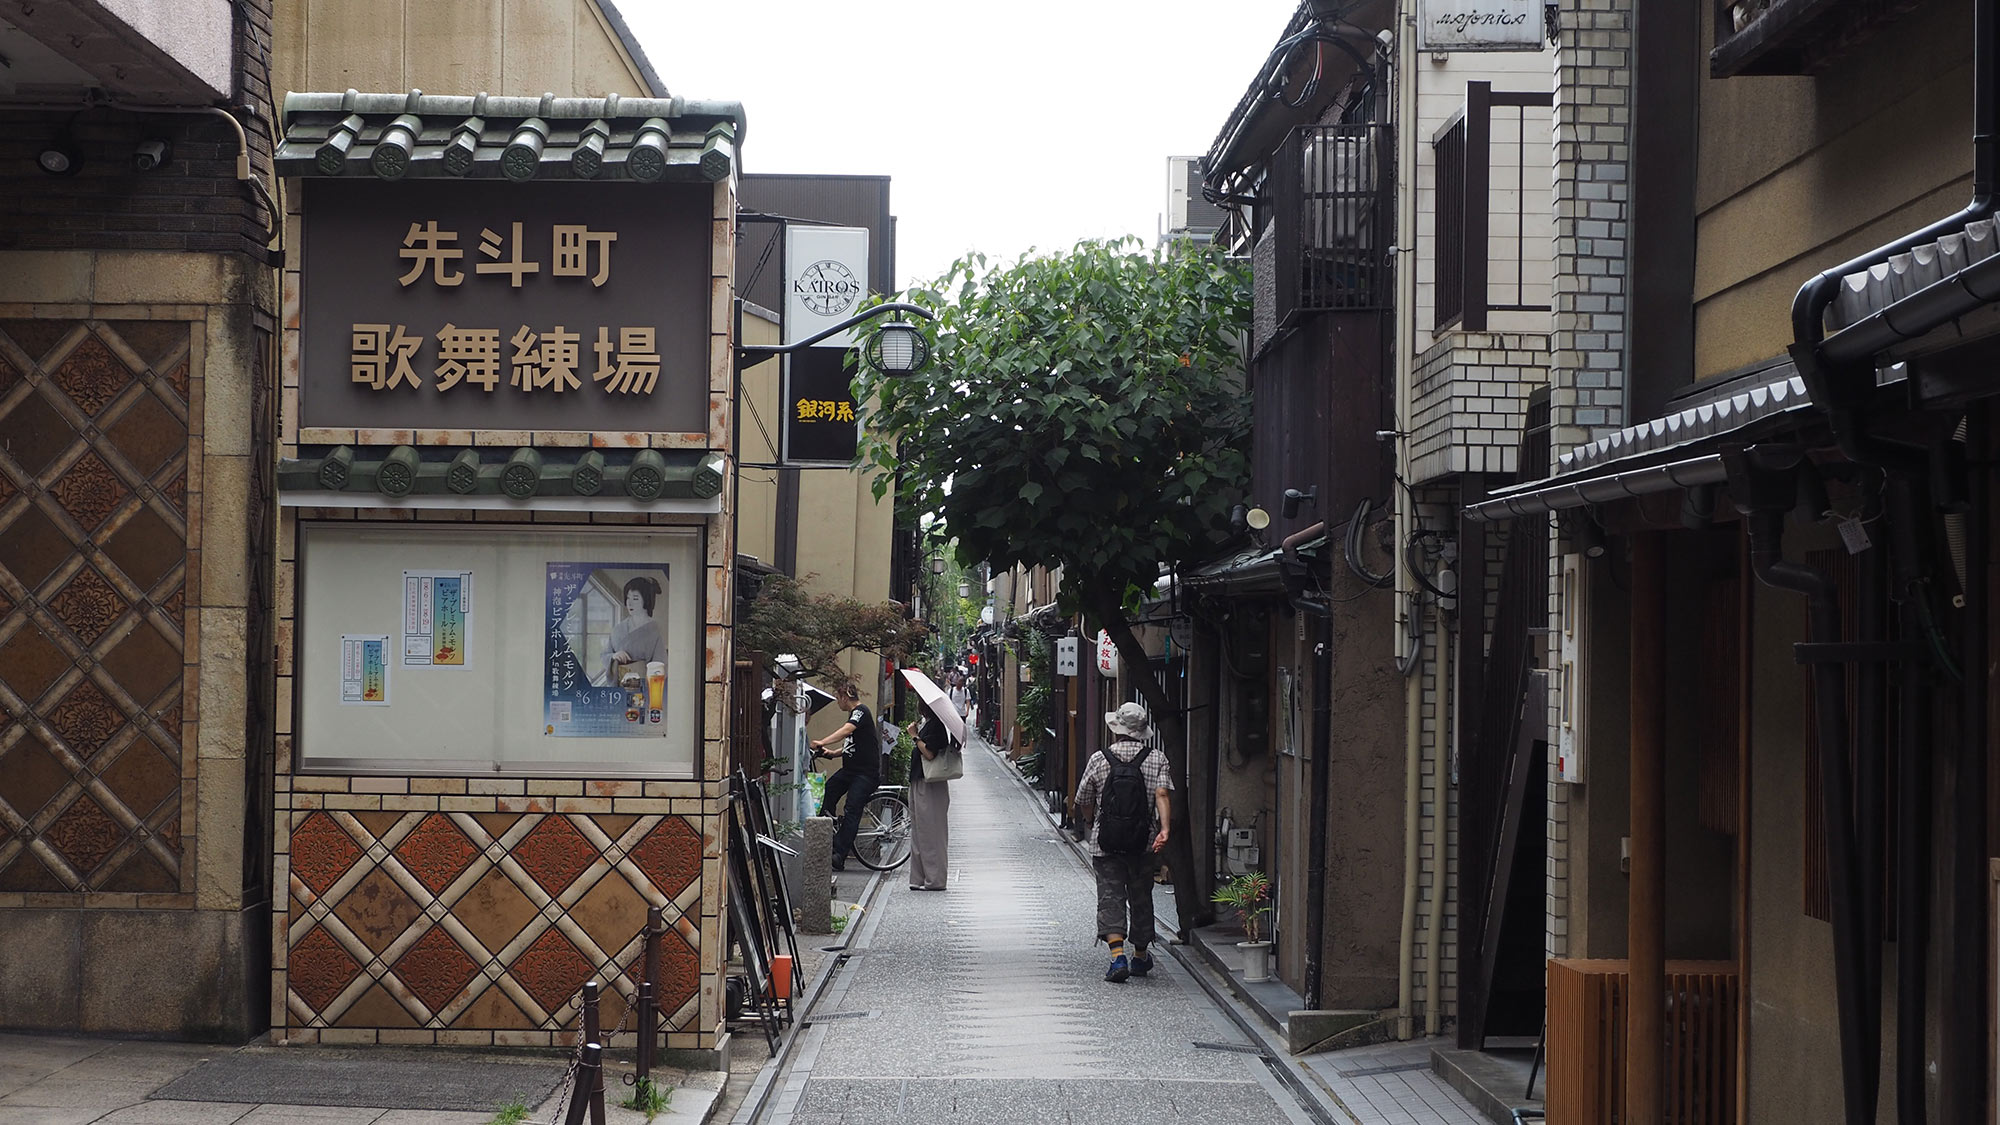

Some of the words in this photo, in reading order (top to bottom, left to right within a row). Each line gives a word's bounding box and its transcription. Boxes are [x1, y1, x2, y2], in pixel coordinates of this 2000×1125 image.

[399, 220, 618, 288] 先斗町
[351, 323, 661, 395] 歌舞練場
[796, 398, 855, 422] 銀河系
[1067, 645, 1076, 668] 焼肉
